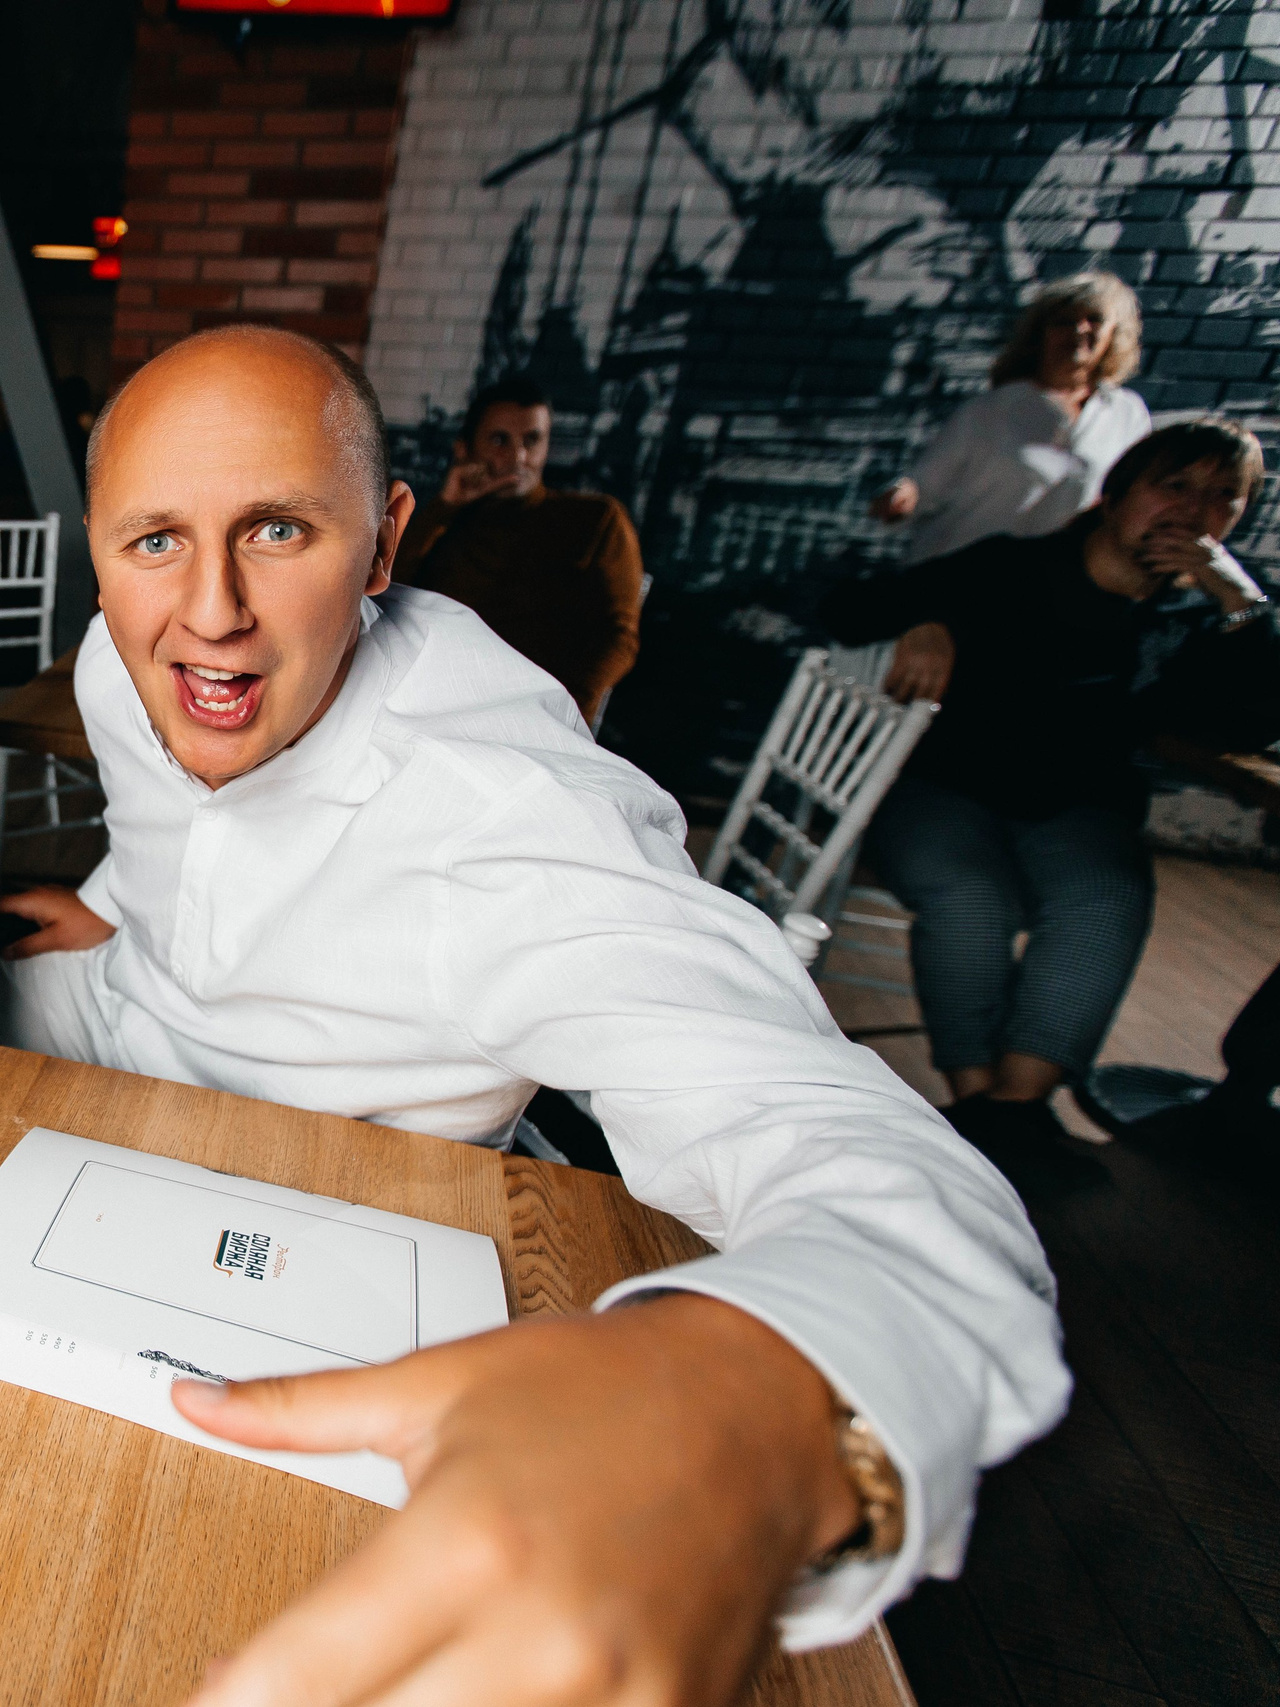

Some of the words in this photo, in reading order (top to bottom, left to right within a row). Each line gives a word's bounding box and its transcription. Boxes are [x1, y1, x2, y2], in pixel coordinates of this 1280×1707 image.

[224, 1231, 250, 1268] БИРЖА
[244, 1233, 271, 1281] СОЛЯНАЯ
[149, 1366, 158, 1379] 560
